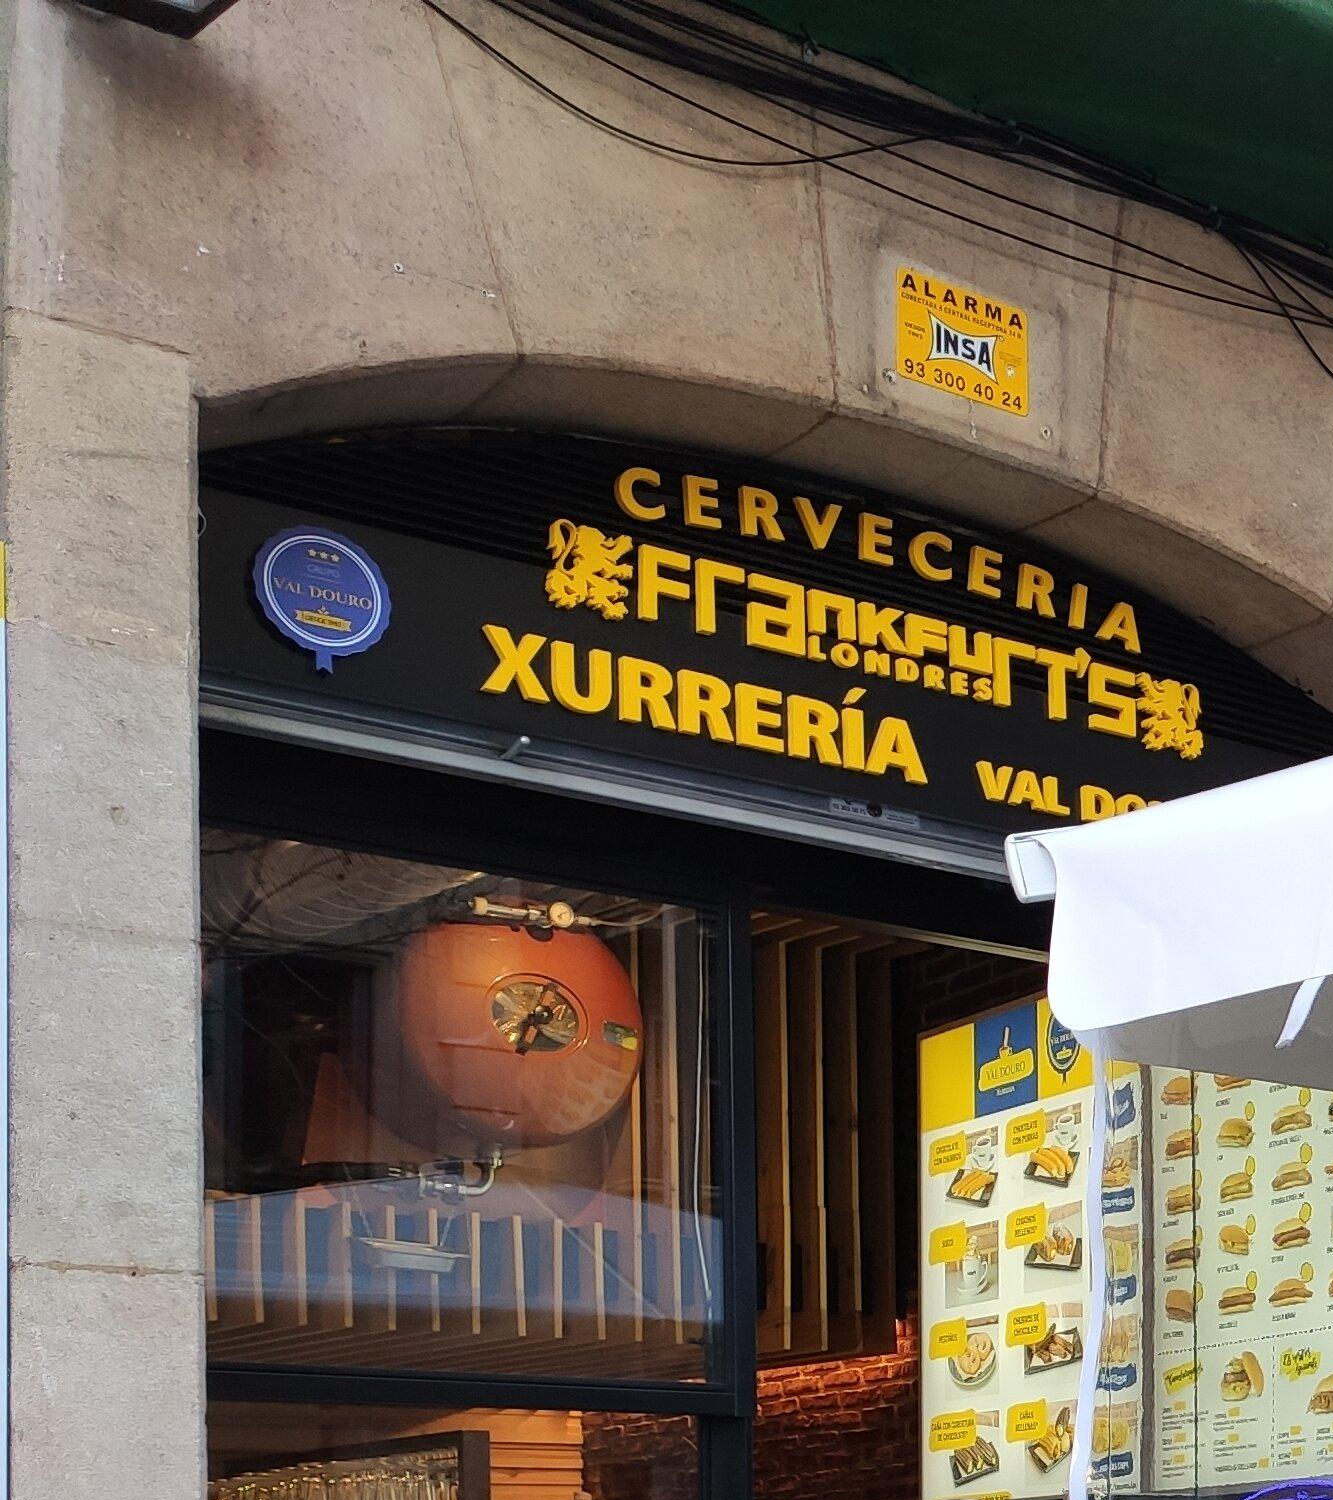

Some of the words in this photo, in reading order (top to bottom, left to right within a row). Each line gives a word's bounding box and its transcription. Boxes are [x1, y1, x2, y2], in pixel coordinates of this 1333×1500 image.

[902, 273, 1023, 330] ALARMA
[935, 322, 992, 373] INSA
[904, 358, 926, 379] 93
[933, 368, 966, 392] 300
[973, 382, 995, 401] 40
[1001, 391, 1023, 411] 24
[614, 466, 1141, 654] CERVECERIA
[273, 576, 304, 595] VAL
[309, 584, 373, 610] DOURO
[807, 634, 994, 702] LONDRES
[480, 623, 929, 785] XURRERÍA
[975, 759, 1071, 817] VAL
[1080, 784, 1166, 822] DO
[985, 1067, 999, 1081] VAL
[1000, 1060, 1027, 1078] DOURO
